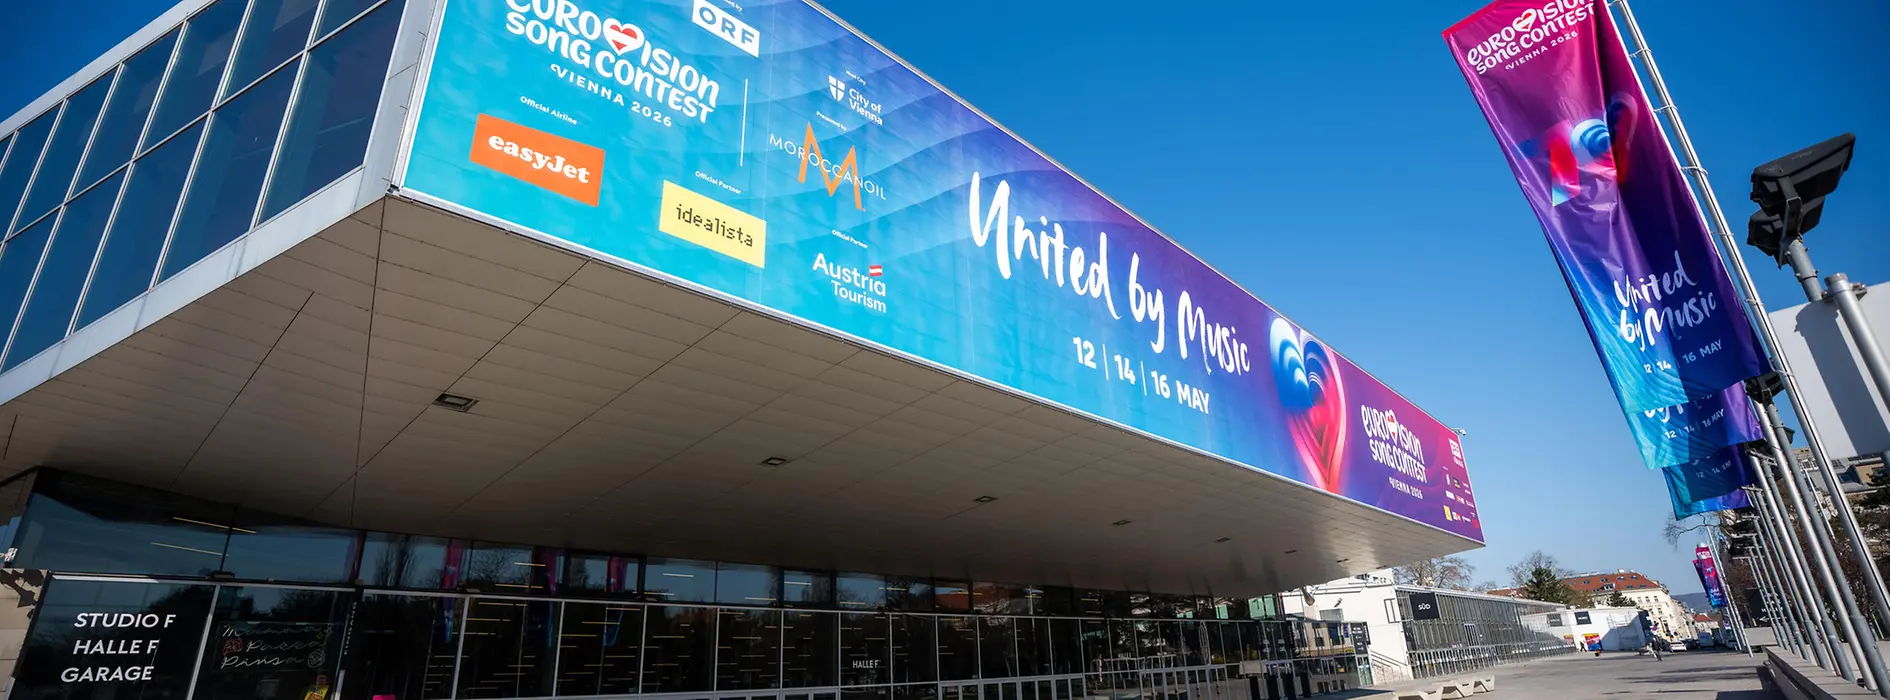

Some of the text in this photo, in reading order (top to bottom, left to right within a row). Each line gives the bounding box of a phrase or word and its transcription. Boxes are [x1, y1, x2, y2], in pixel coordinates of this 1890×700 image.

[699, 6, 755, 45] ORF
[1476, 2, 1595, 75] SONG CONTEST
[506, 11, 714, 123] SONG CONTEST
[1505, 30, 1578, 70] VIENNA 2026
[519, 95, 578, 125] Official Airline
[550, 63, 672, 127] VIENNA 2026
[848, 97, 883, 126] Vienna
[849, 87, 882, 114] City of
[488, 133, 590, 185] easyJet
[769, 133, 887, 201] MOROCCANOIL
[695, 170, 742, 195] Official Partner
[676, 203, 753, 247] idealista
[831, 229, 850, 243] Official
[812, 251, 887, 297] Austria
[969, 171, 1250, 376] United by Music
[1613, 250, 1697, 313] United
[830, 279, 887, 313] Tourism
[1620, 290, 1717, 352] by Music
[1073, 337, 1210, 414] 12 14 16 MAY
[1643, 339, 1723, 374] 12 14 16 MAY
[1665, 430, 1677, 439] 12
[1684, 425, 1695, 434] 14
[1702, 418, 1711, 428] 16
[1711, 408, 1724, 423] MAY
[1369, 438, 1396, 470] SONG
[1392, 445, 1428, 484] CONTEST
[1388, 476, 1423, 500] VIENNA 2026
[73, 612, 177, 629] STUDIO F
[72, 638, 161, 656] HALLE F
[852, 659, 879, 669] HALLE F
[60, 665, 155, 683] GARAGE
